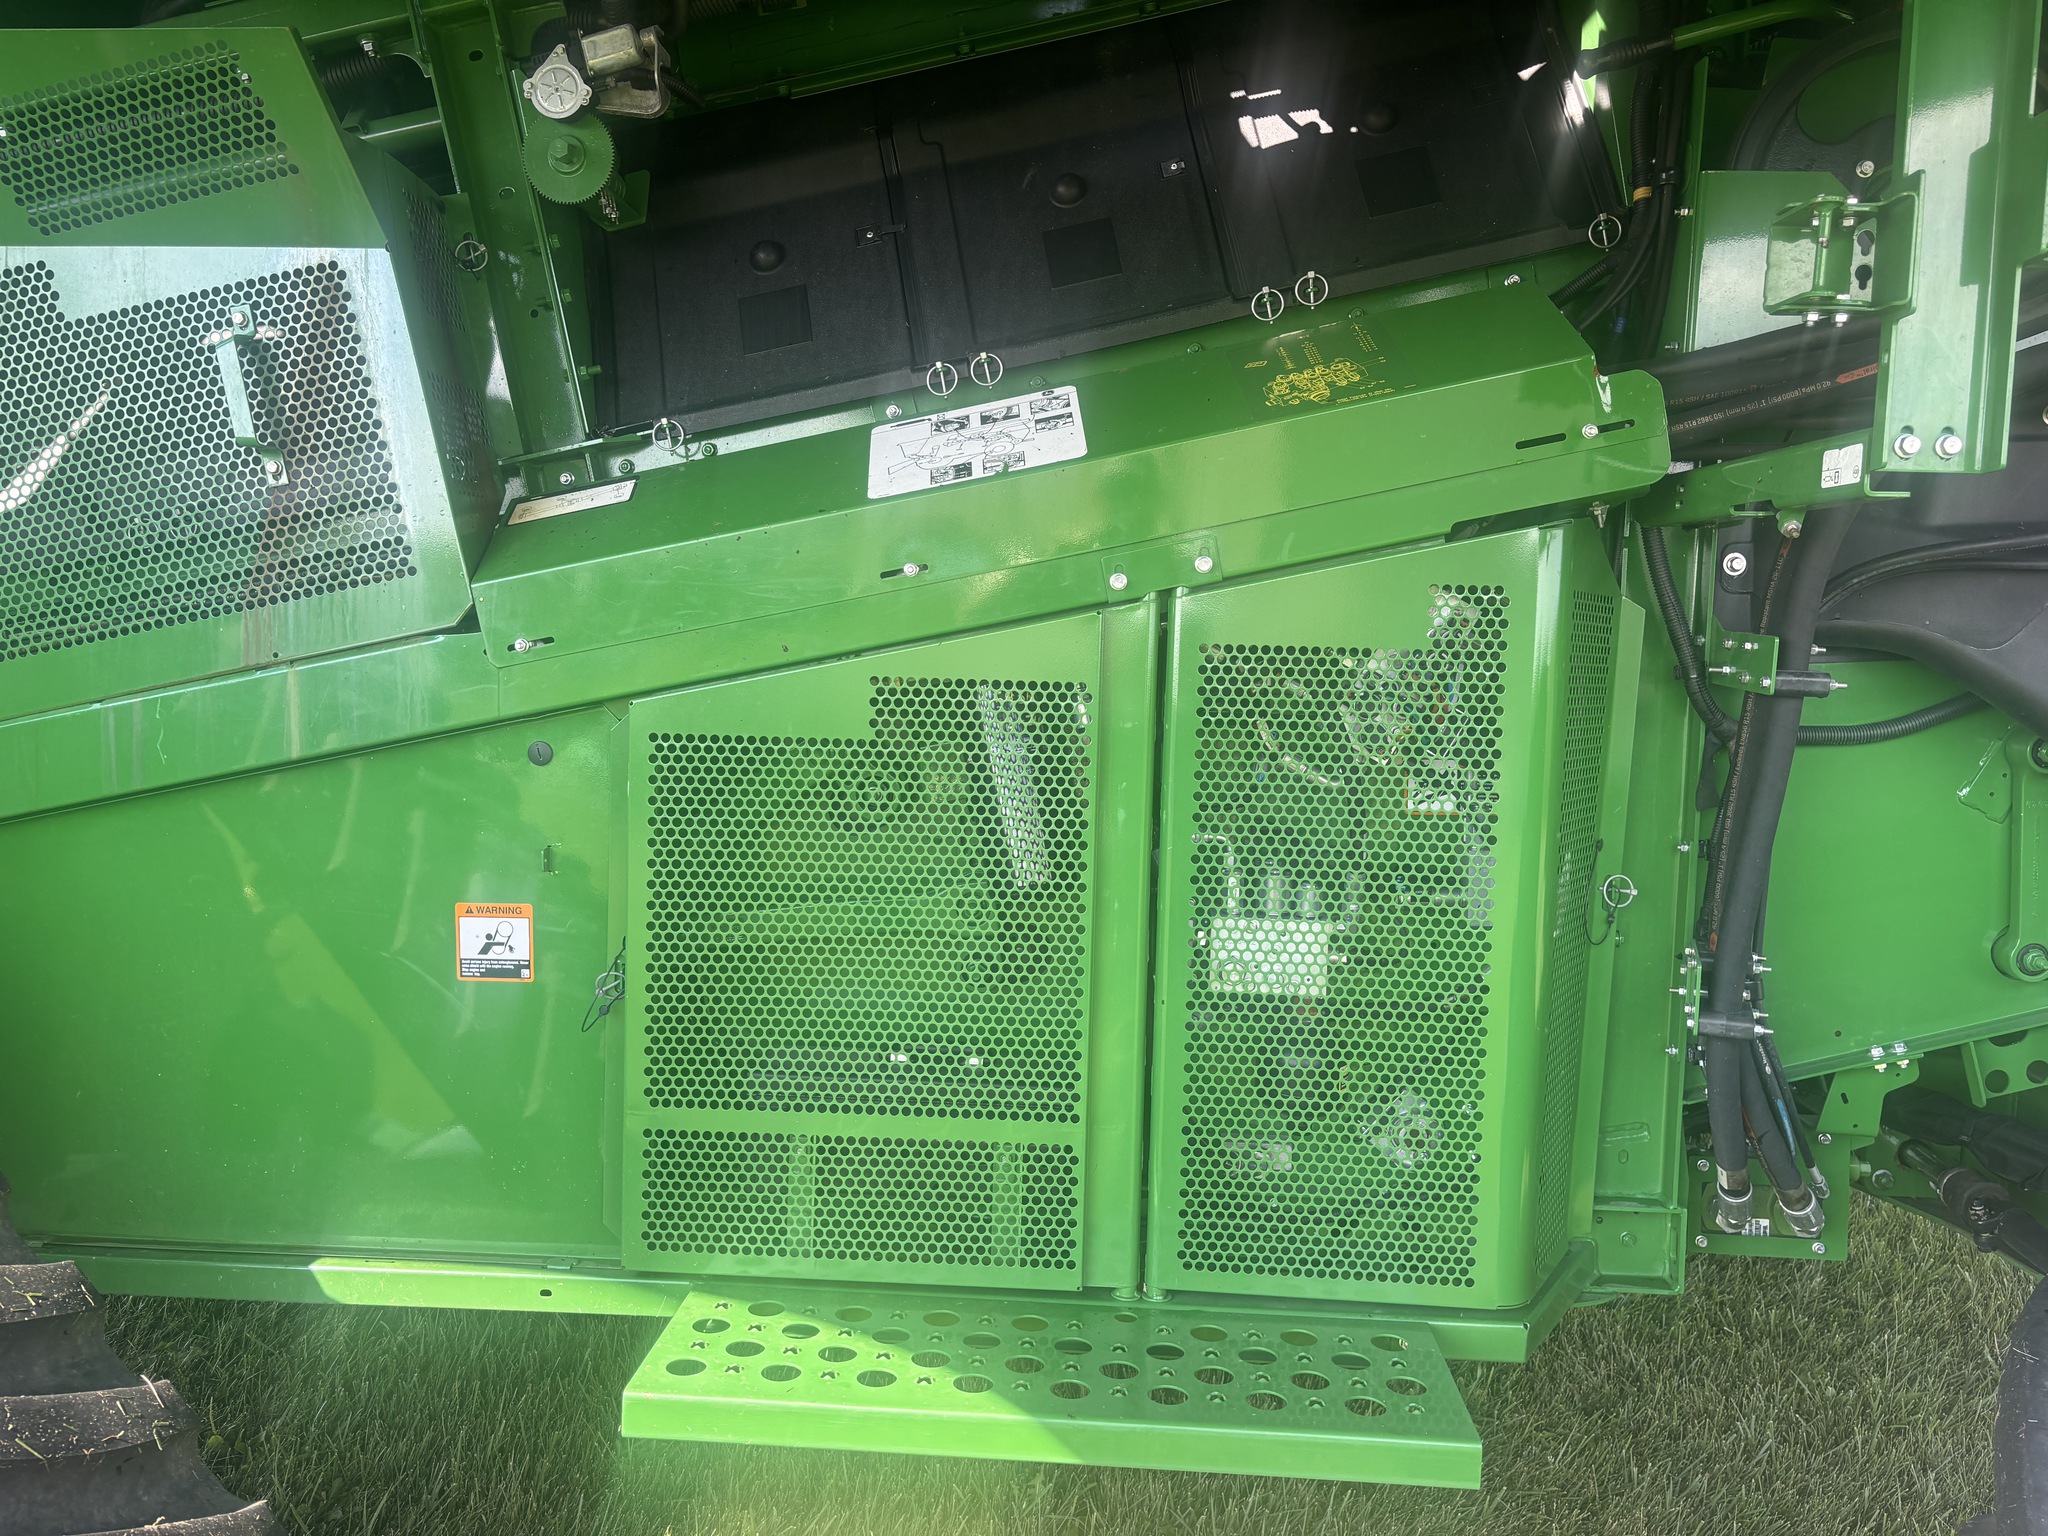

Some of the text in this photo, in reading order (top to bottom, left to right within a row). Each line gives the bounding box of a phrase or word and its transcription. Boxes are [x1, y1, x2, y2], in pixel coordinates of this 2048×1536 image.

[1782, 387, 1802, 400] (6000
[1802, 384, 1816, 393] MPa
[1768, 395, 1782, 406] PSI)
[1714, 412, 1724, 420] ISO
[1684, 420, 1697, 429] R15
[1760, 600, 1770, 628] Resistant
[1766, 580, 1776, 599] MSHA
[1736, 746, 1745, 770] Exceeds
[1722, 830, 1730, 844] mm)
[1716, 870, 1724, 882] PSI)
[1714, 882, 1722, 902] (6000
[476, 906, 523, 915] WARNING
